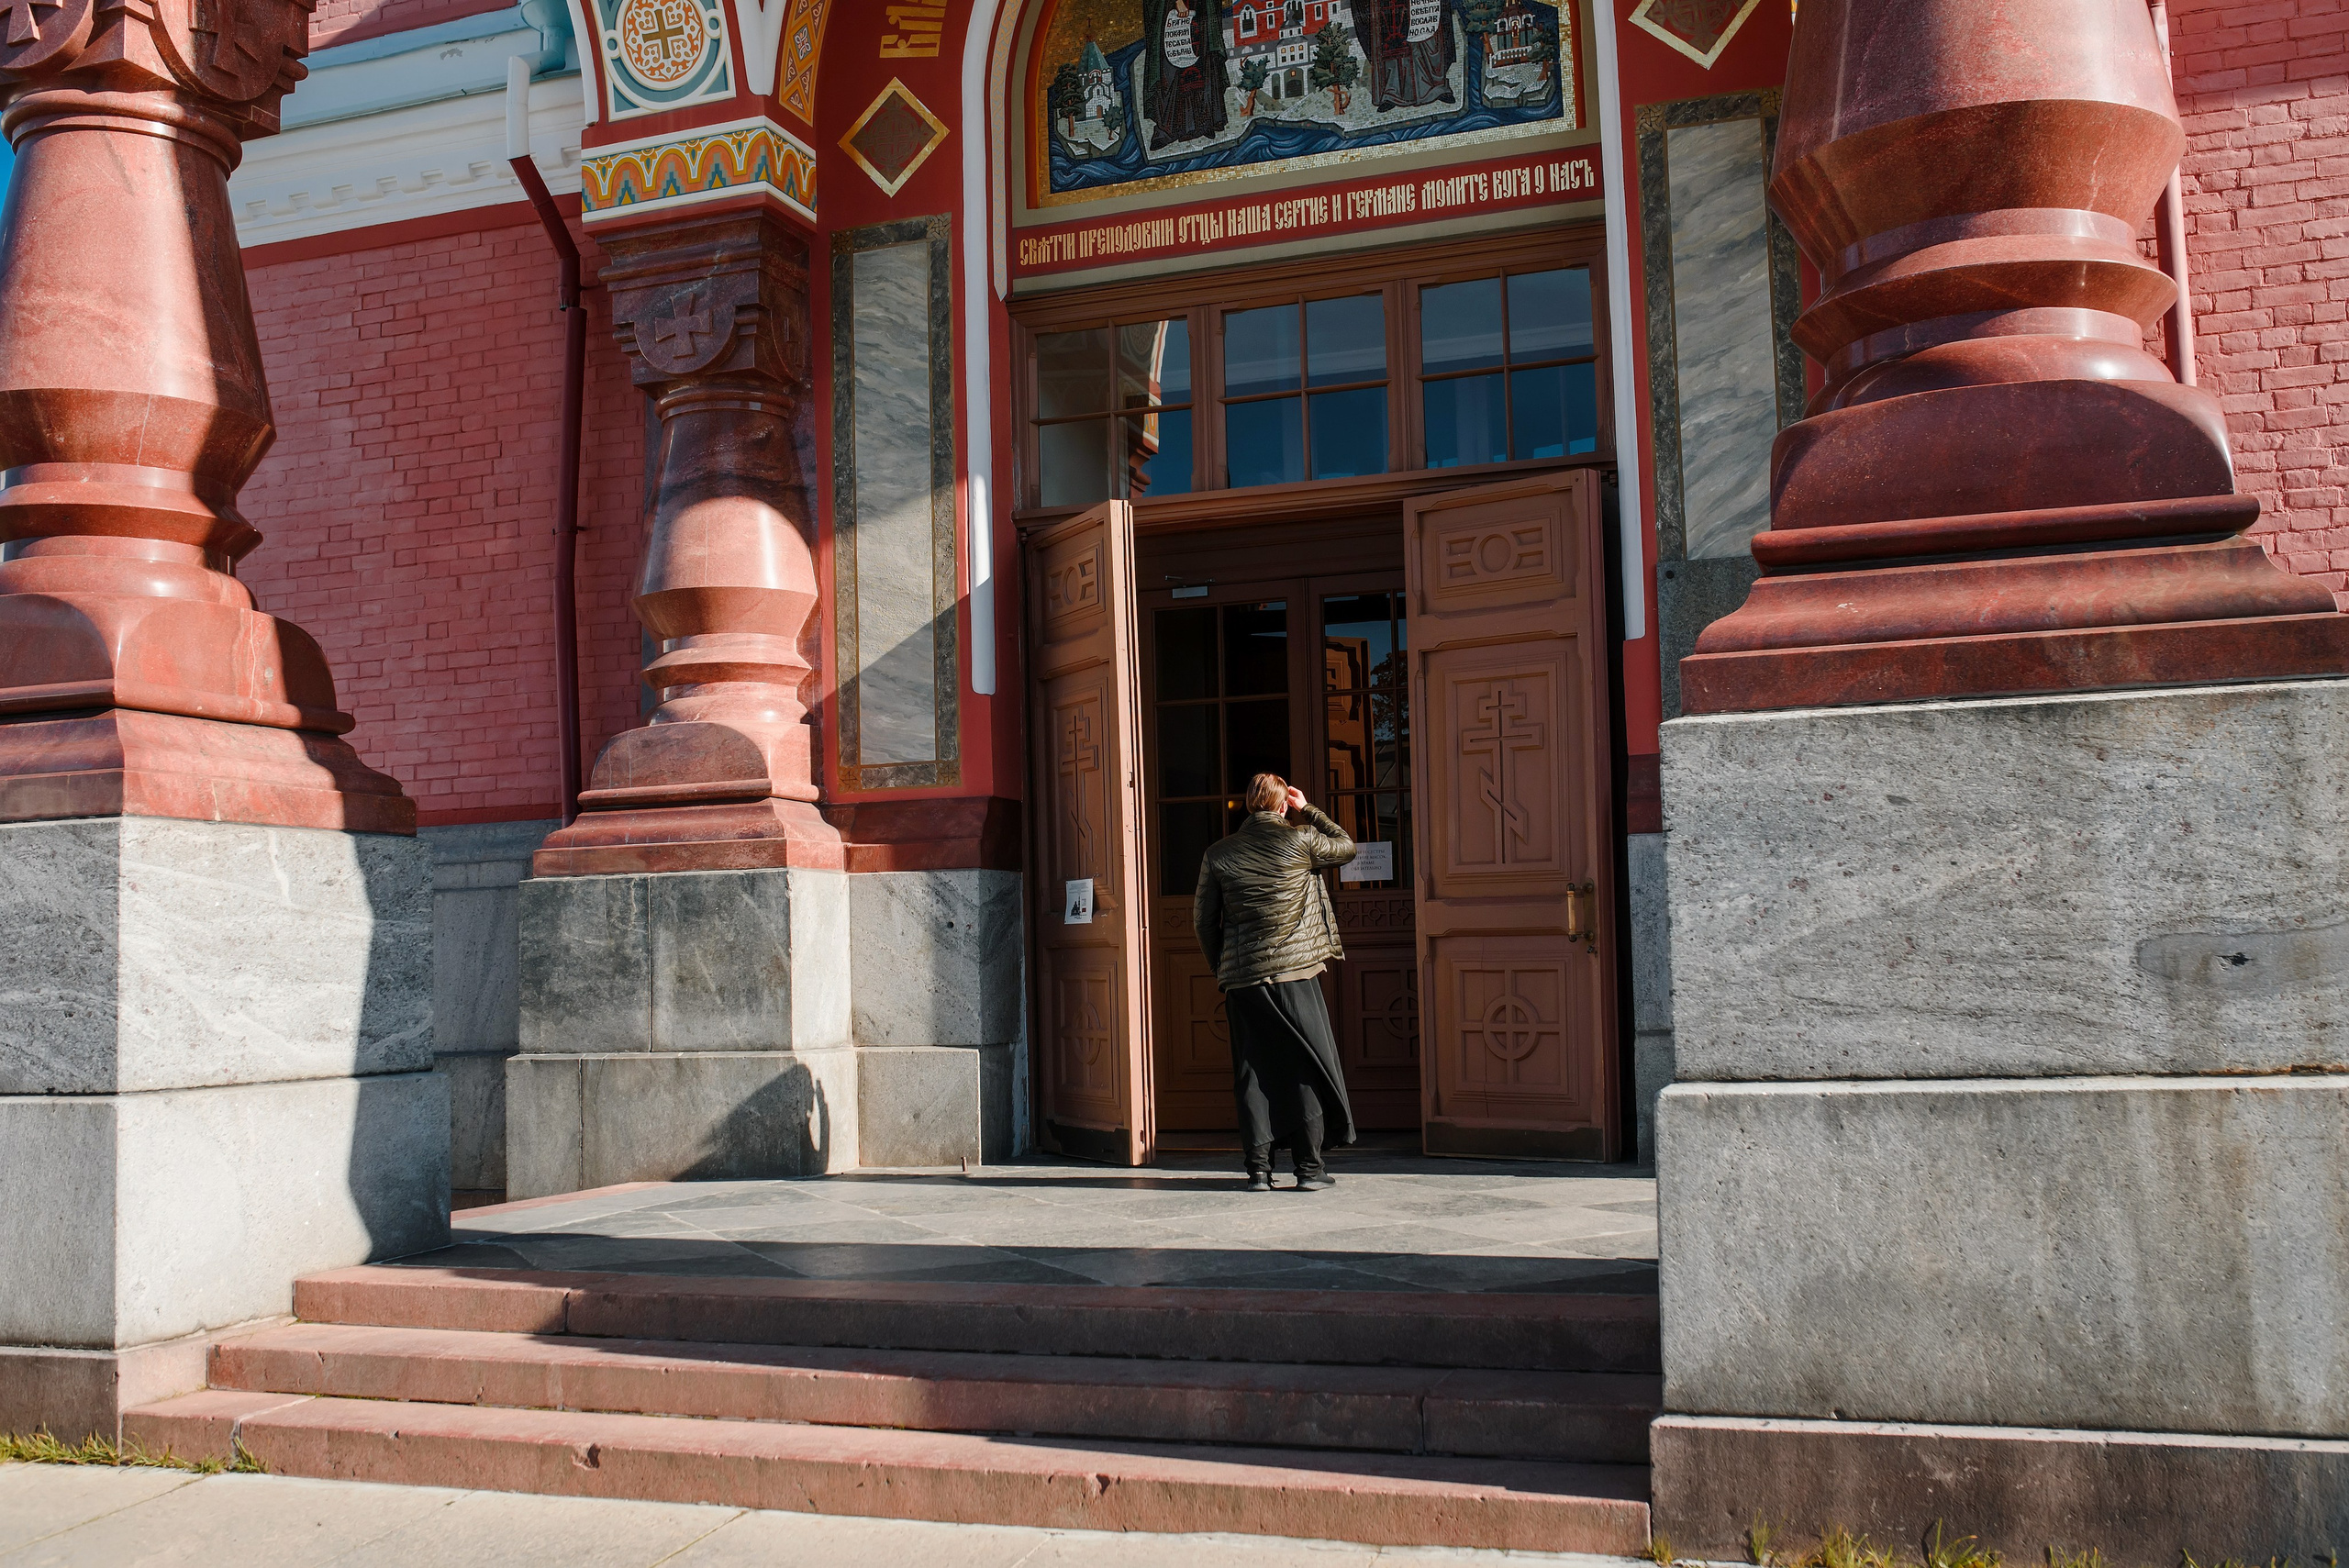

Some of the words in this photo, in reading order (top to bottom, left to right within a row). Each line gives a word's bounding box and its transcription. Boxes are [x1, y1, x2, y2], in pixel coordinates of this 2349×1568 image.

[1178, 211, 1224, 245] ОТЦЫ
[1227, 204, 1271, 237] НАША
[1274, 195, 1328, 229] СЕРГИЕ
[1331, 194, 1342, 223] И
[1346, 183, 1416, 220] ГЕРМАНЕ
[1421, 172, 1488, 210] МОЛИТЕ
[1492, 166, 1531, 200] БОГА
[1534, 164, 1545, 195] О
[1549, 159, 1595, 193] НАСЪ
